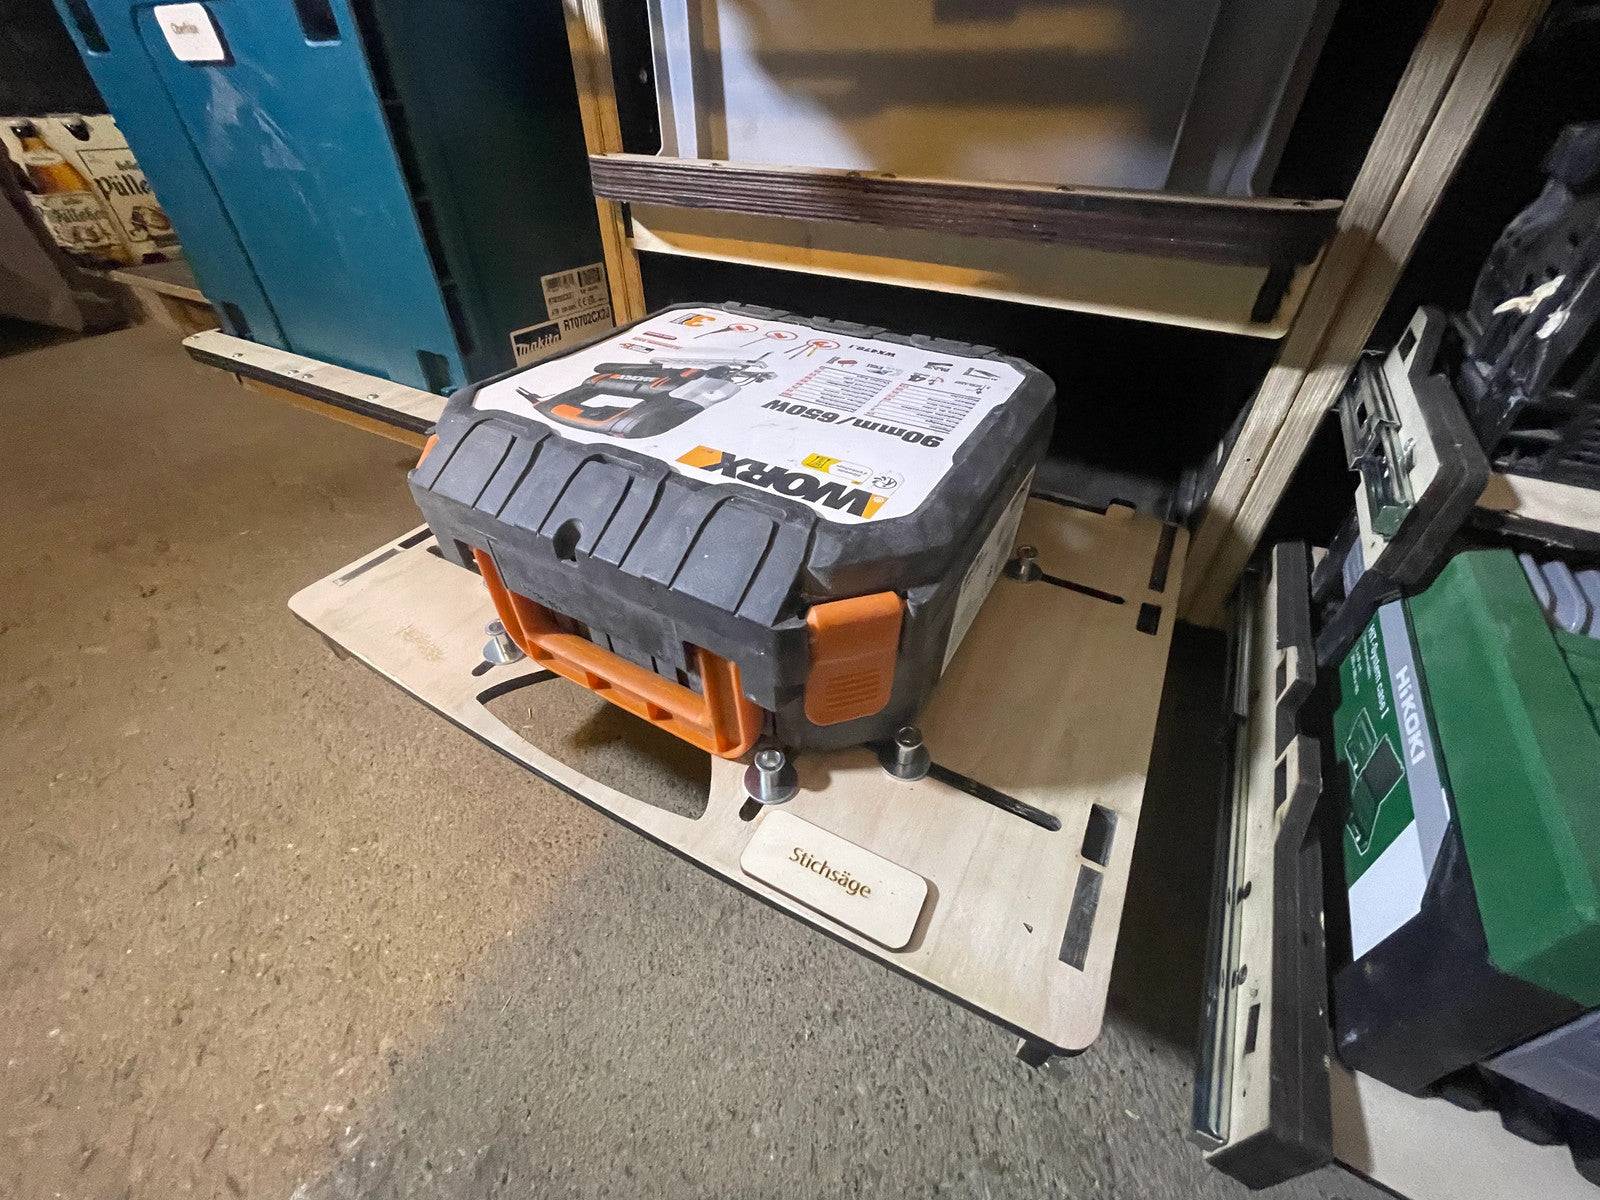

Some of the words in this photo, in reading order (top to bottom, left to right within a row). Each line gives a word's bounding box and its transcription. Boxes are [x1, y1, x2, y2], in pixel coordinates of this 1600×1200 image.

[516, 332, 561, 356] makita
[760, 400, 944, 449] 90mm/650W
[703, 452, 872, 518] WORX
[1395, 665, 1426, 765] HiKOKI
[788, 847, 871, 899] Stichsäge
